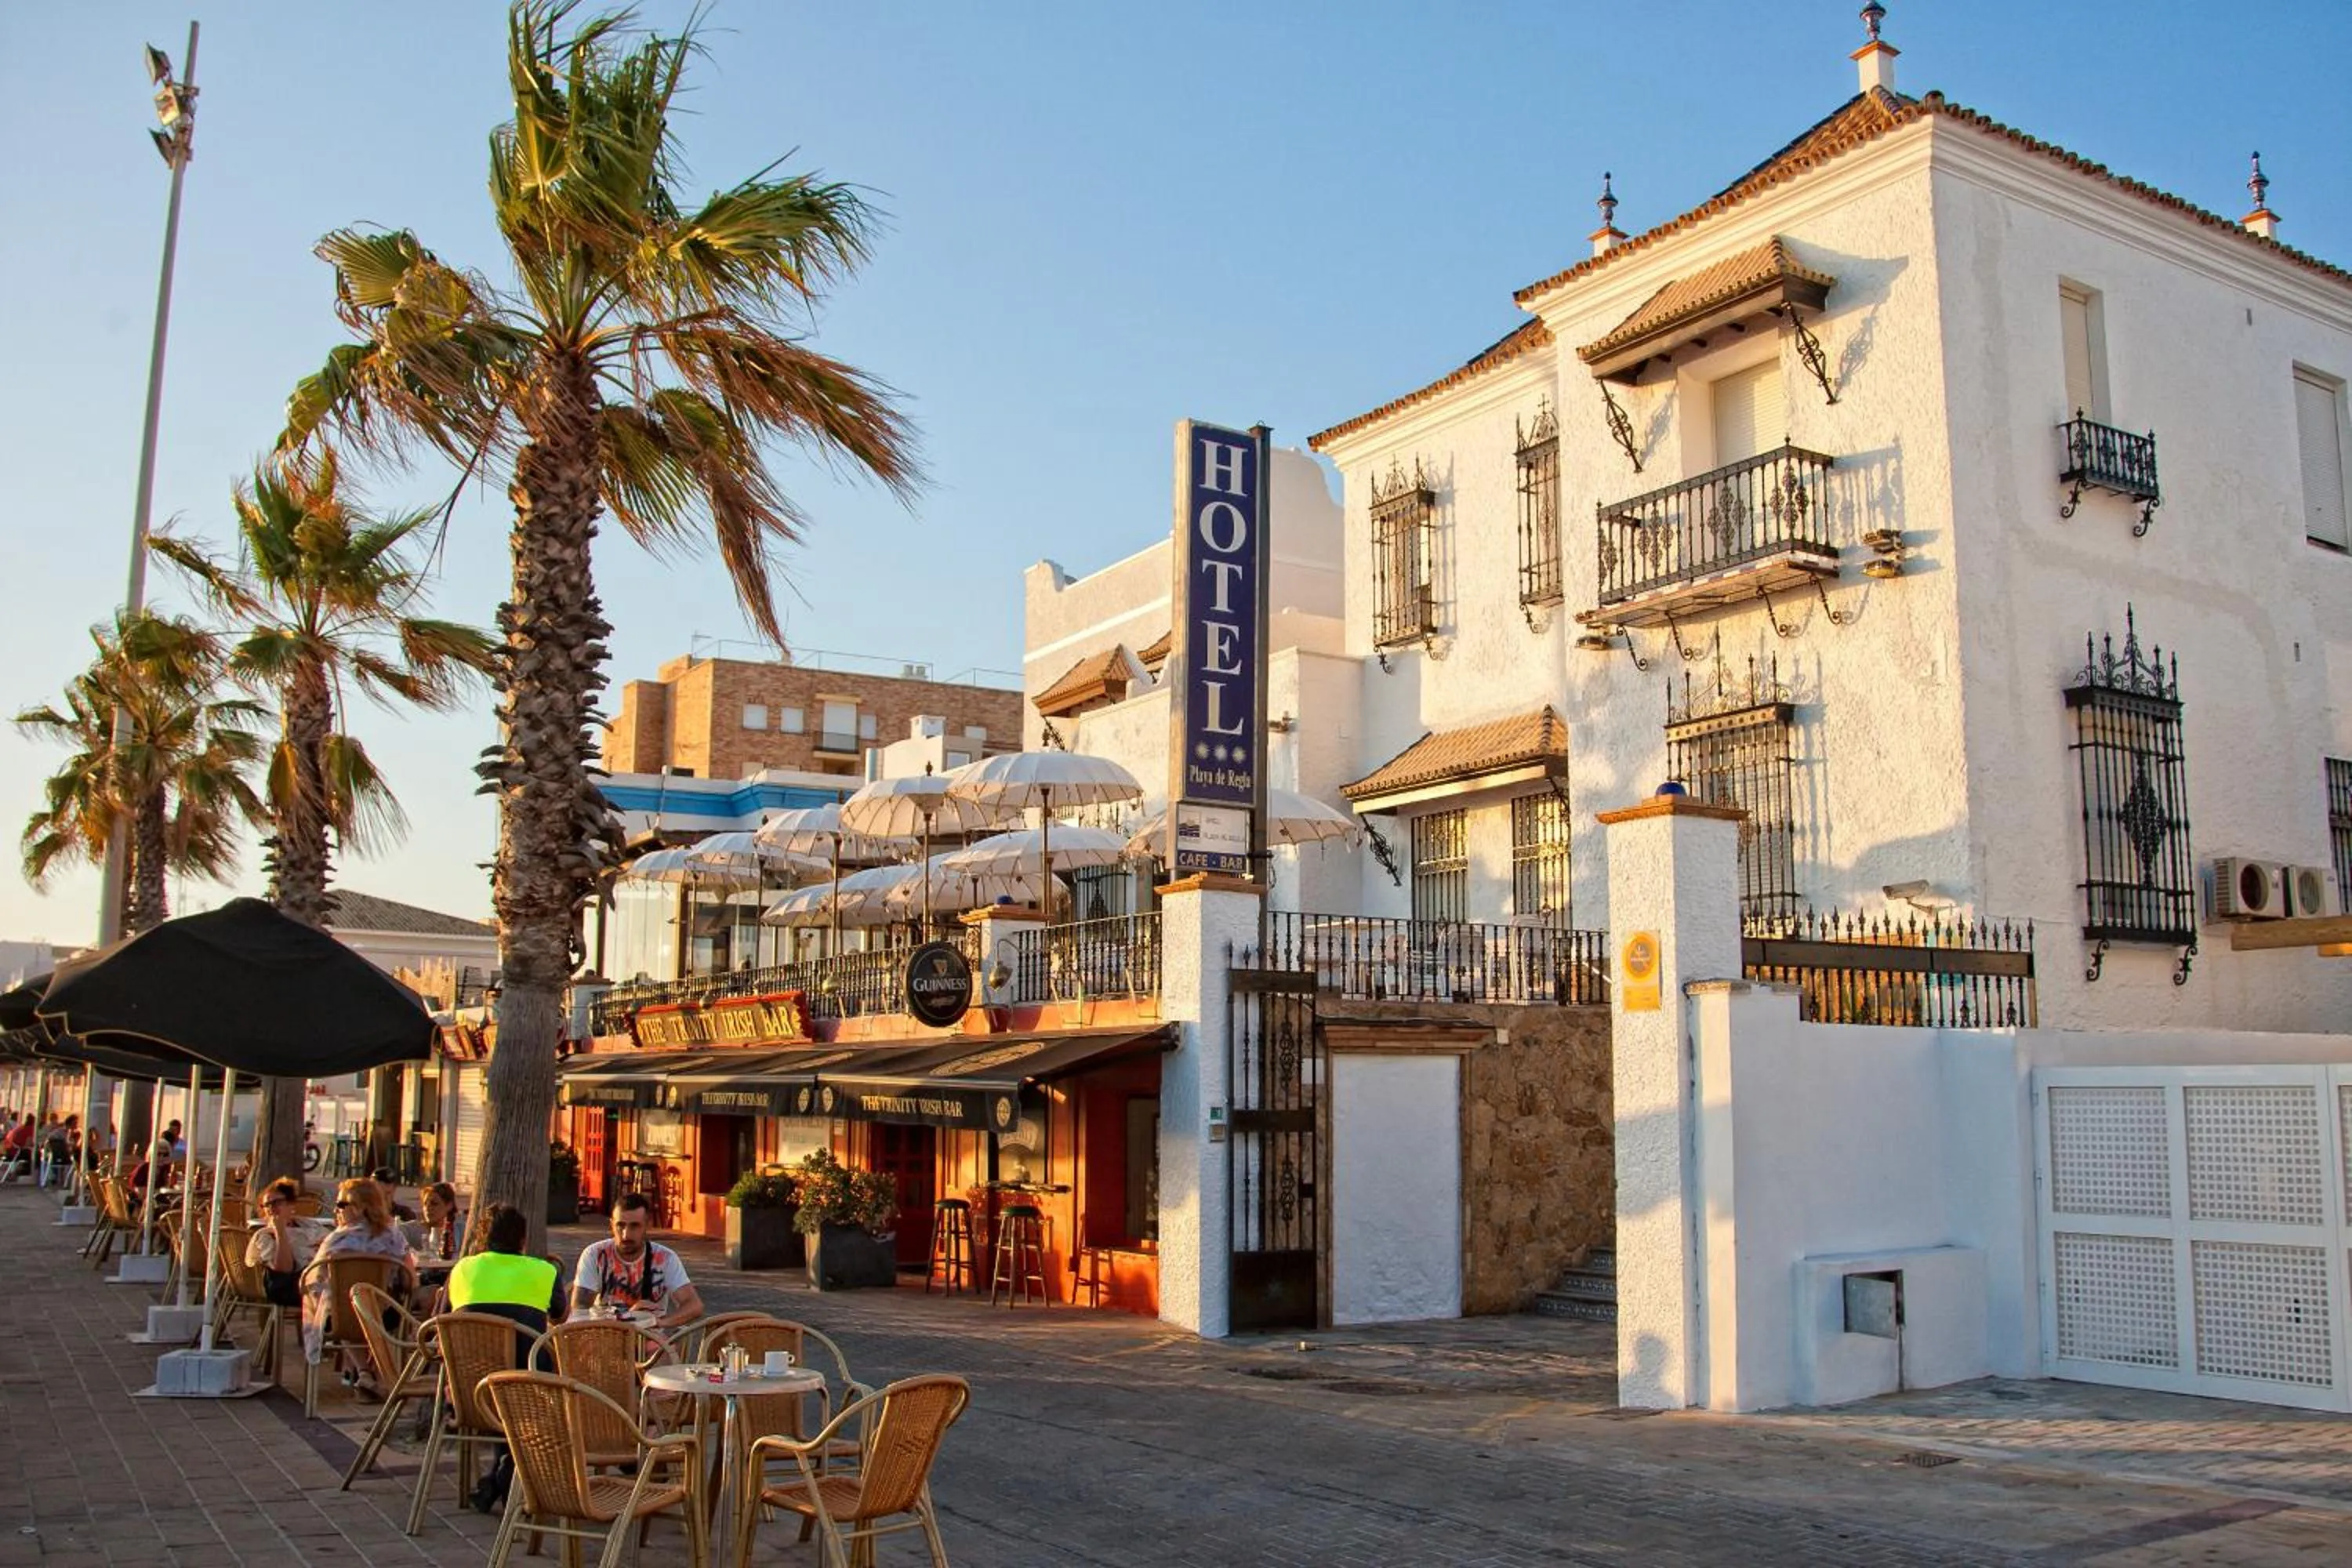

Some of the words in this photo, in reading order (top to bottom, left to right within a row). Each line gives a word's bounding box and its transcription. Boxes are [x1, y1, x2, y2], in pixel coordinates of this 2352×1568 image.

[1199, 437, 1248, 736] HOTEL
[1215, 768, 1225, 786] de
[1220, 855, 1243, 869] BAR
[913, 978, 967, 992] GUINNESS
[644, 1018, 666, 1044] THE
[670, 1012, 717, 1042] TRINITY
[721, 1008, 757, 1039] IRISH
[760, 1006, 793, 1036] BAR
[861, 1095, 880, 1111] THE
[880, 1096, 916, 1114] TRINITY
[943, 1100, 964, 1117] BAR
